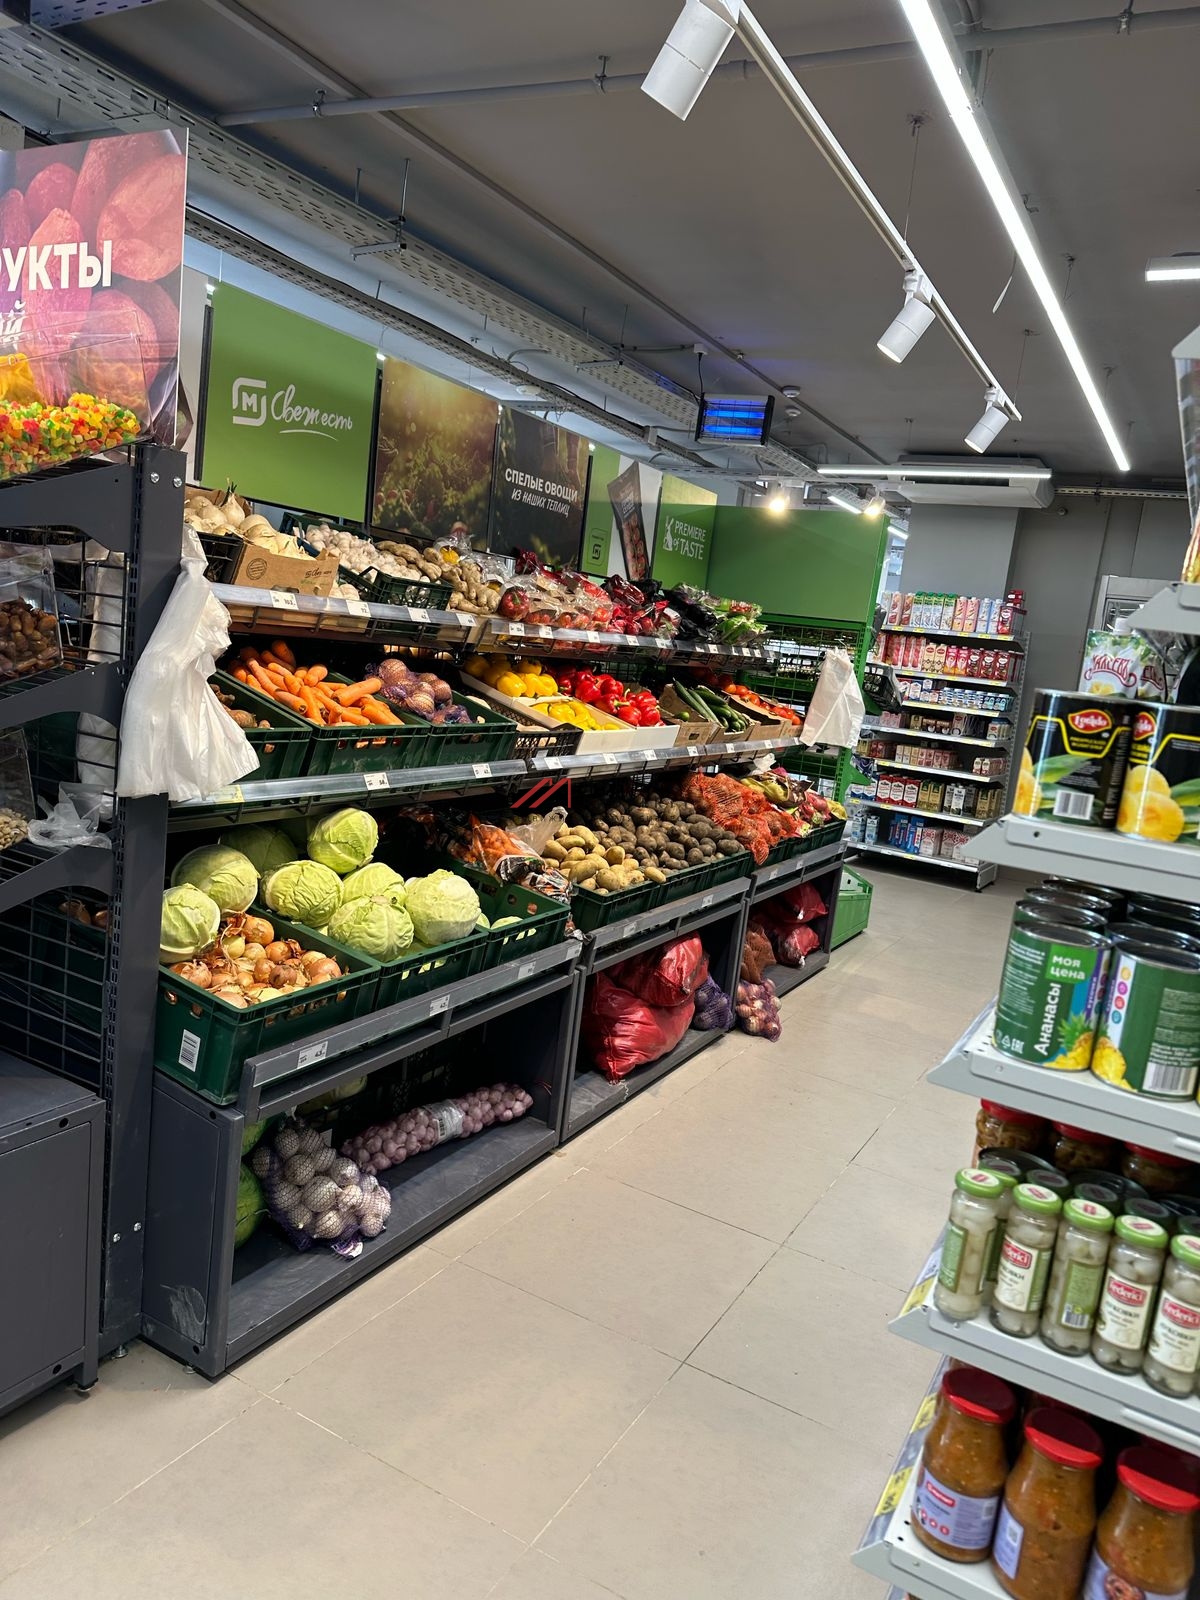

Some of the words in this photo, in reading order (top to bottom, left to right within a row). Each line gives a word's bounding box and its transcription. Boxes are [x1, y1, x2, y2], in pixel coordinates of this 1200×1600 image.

[0, 240, 112, 291] УКТЫ
[505, 468, 543, 492] СПЕЛЫЕ
[544, 481, 578, 502] ОВОЩИ
[512, 488, 521, 501] ИЗ
[522, 491, 545, 508] НАШИХ
[546, 498, 570, 518] ТЕПЛИЦ
[675, 520, 707, 542] PREMIERE
[680, 539, 704, 560] TASTE
[1050, 967, 1086, 981] цена
[1053, 955, 1081, 968] моя
[1034, 983, 1062, 1056] Ананасы
